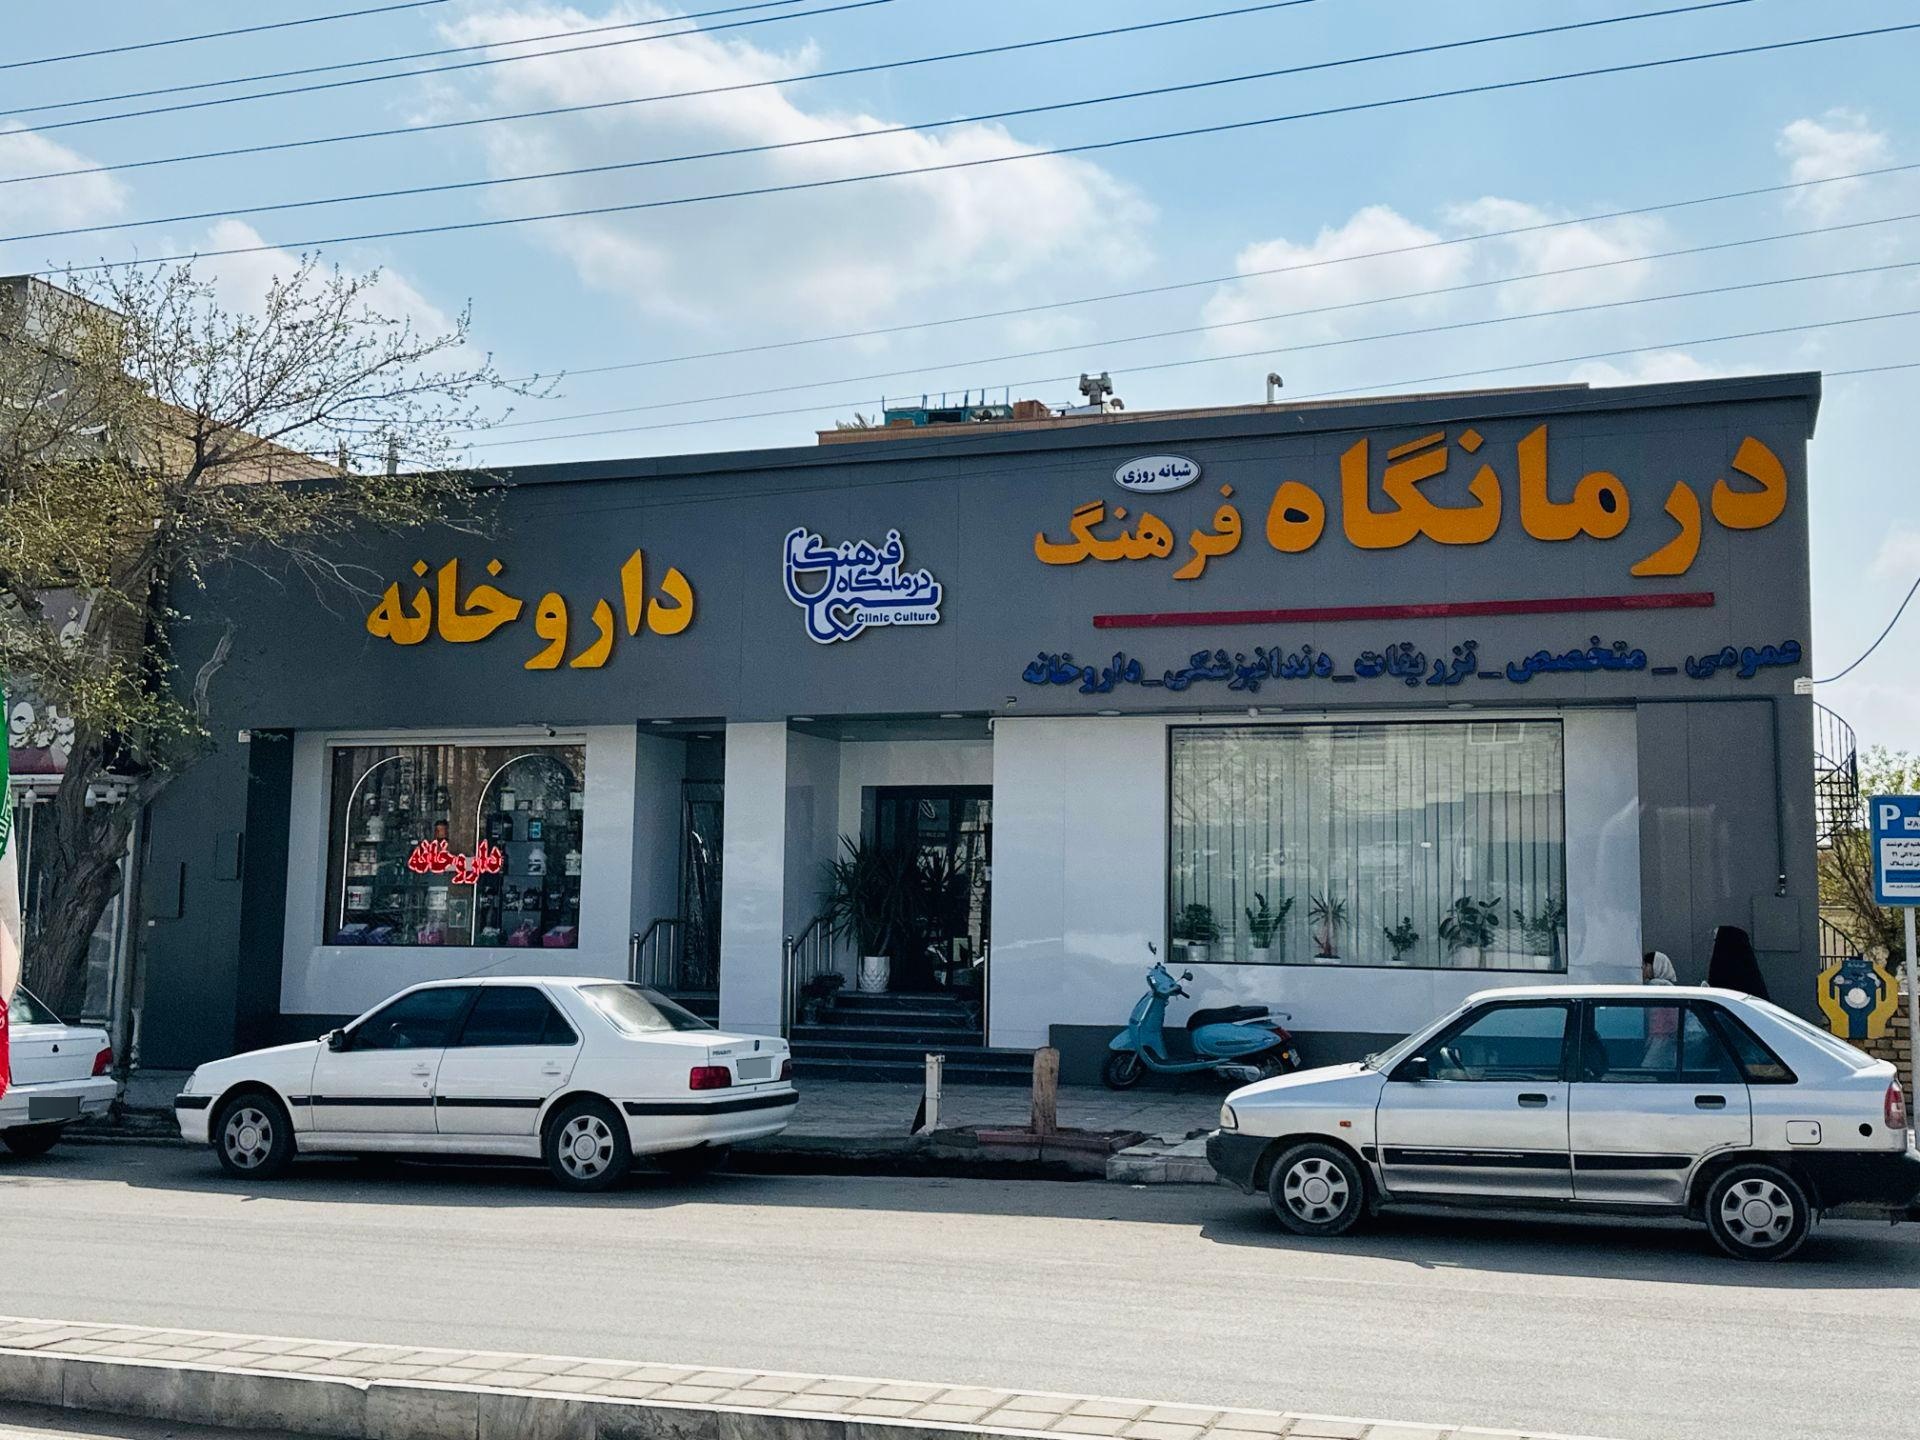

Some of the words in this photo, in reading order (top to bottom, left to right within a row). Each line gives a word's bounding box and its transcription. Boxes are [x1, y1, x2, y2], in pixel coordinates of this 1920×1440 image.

[1123, 469, 1155, 484] روزی
[1159, 463, 1191, 480] شبانه
[1266, 425, 1787, 577] درمانگاه
[1034, 483, 1242, 580] فرهنگ
[837, 567, 931, 597] درمانگاه
[366, 548, 695, 670] داروخانه
[856, 612, 890, 623] Clinic
[894, 611, 937, 622] Culture
[1022, 651, 1143, 694] داروخانه
[1163, 643, 1333, 693] دندانپزشکی
[1354, 639, 1478, 688] تزریقات
[1685, 639, 1802, 679] عمومی
[1879, 804, 1901, 830] P
[408, 838, 502, 885] داروخانه
